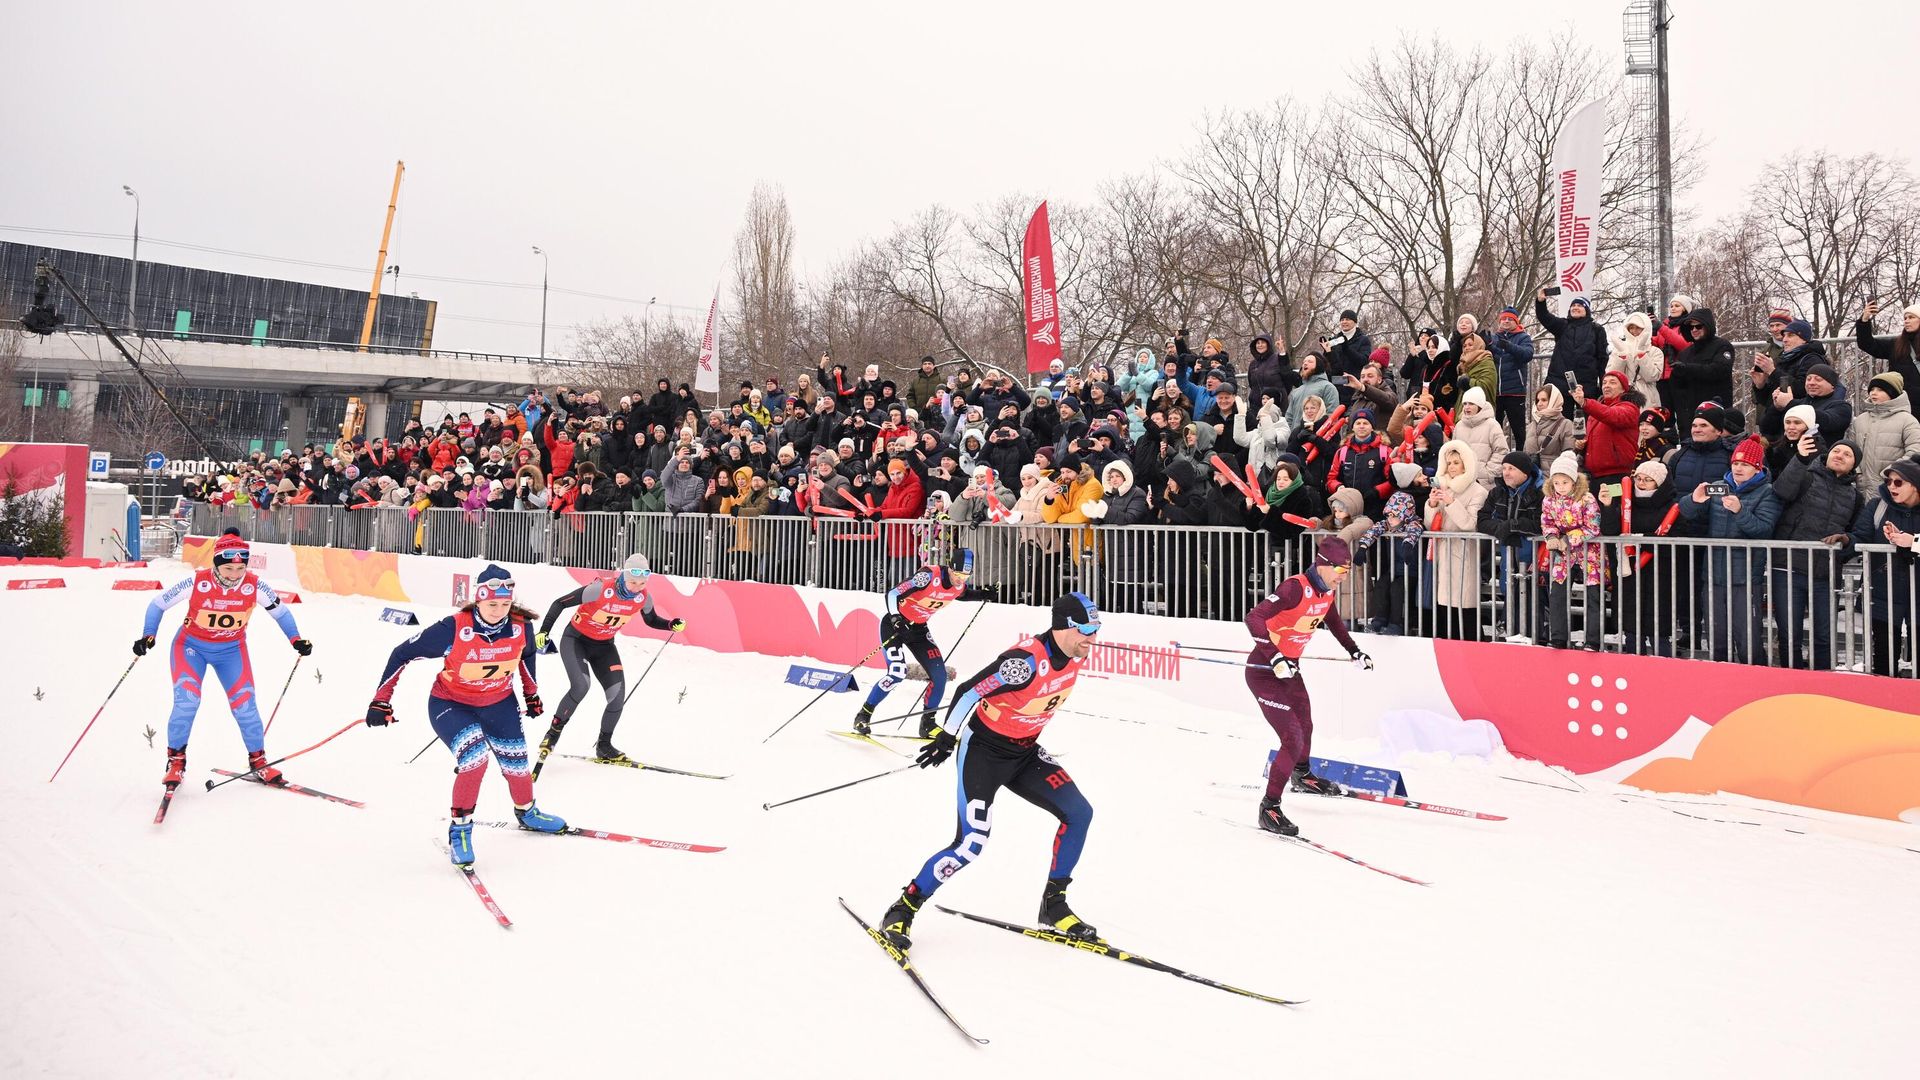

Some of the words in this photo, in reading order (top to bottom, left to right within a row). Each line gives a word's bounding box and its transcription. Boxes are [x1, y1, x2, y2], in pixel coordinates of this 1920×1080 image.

[1559, 169, 1576, 258] МОСКОВСКИЙ
[1572, 216, 1591, 257] СПОРТ
[1028, 256, 1043, 323] МОСКОВСКИЙ
[1043, 287, 1054, 319] СПОРТ
[95, 460, 104, 471] P
[928, 600, 944, 609] 12
[208, 614, 235, 628] 10
[605, 615, 621, 627] 11
[1310, 618, 1320, 630] 9
[1019, 633, 1181, 681] КОВСКИЙ
[482, 665, 500, 679] 7
[1044, 695, 1061, 711] 8
[1426, 803, 1469, 816] MADSHUS
[651, 839, 692, 850] MADSHUS
[866, 927, 903, 961] FISCHER
[1022, 928, 1109, 956] FISCHER
